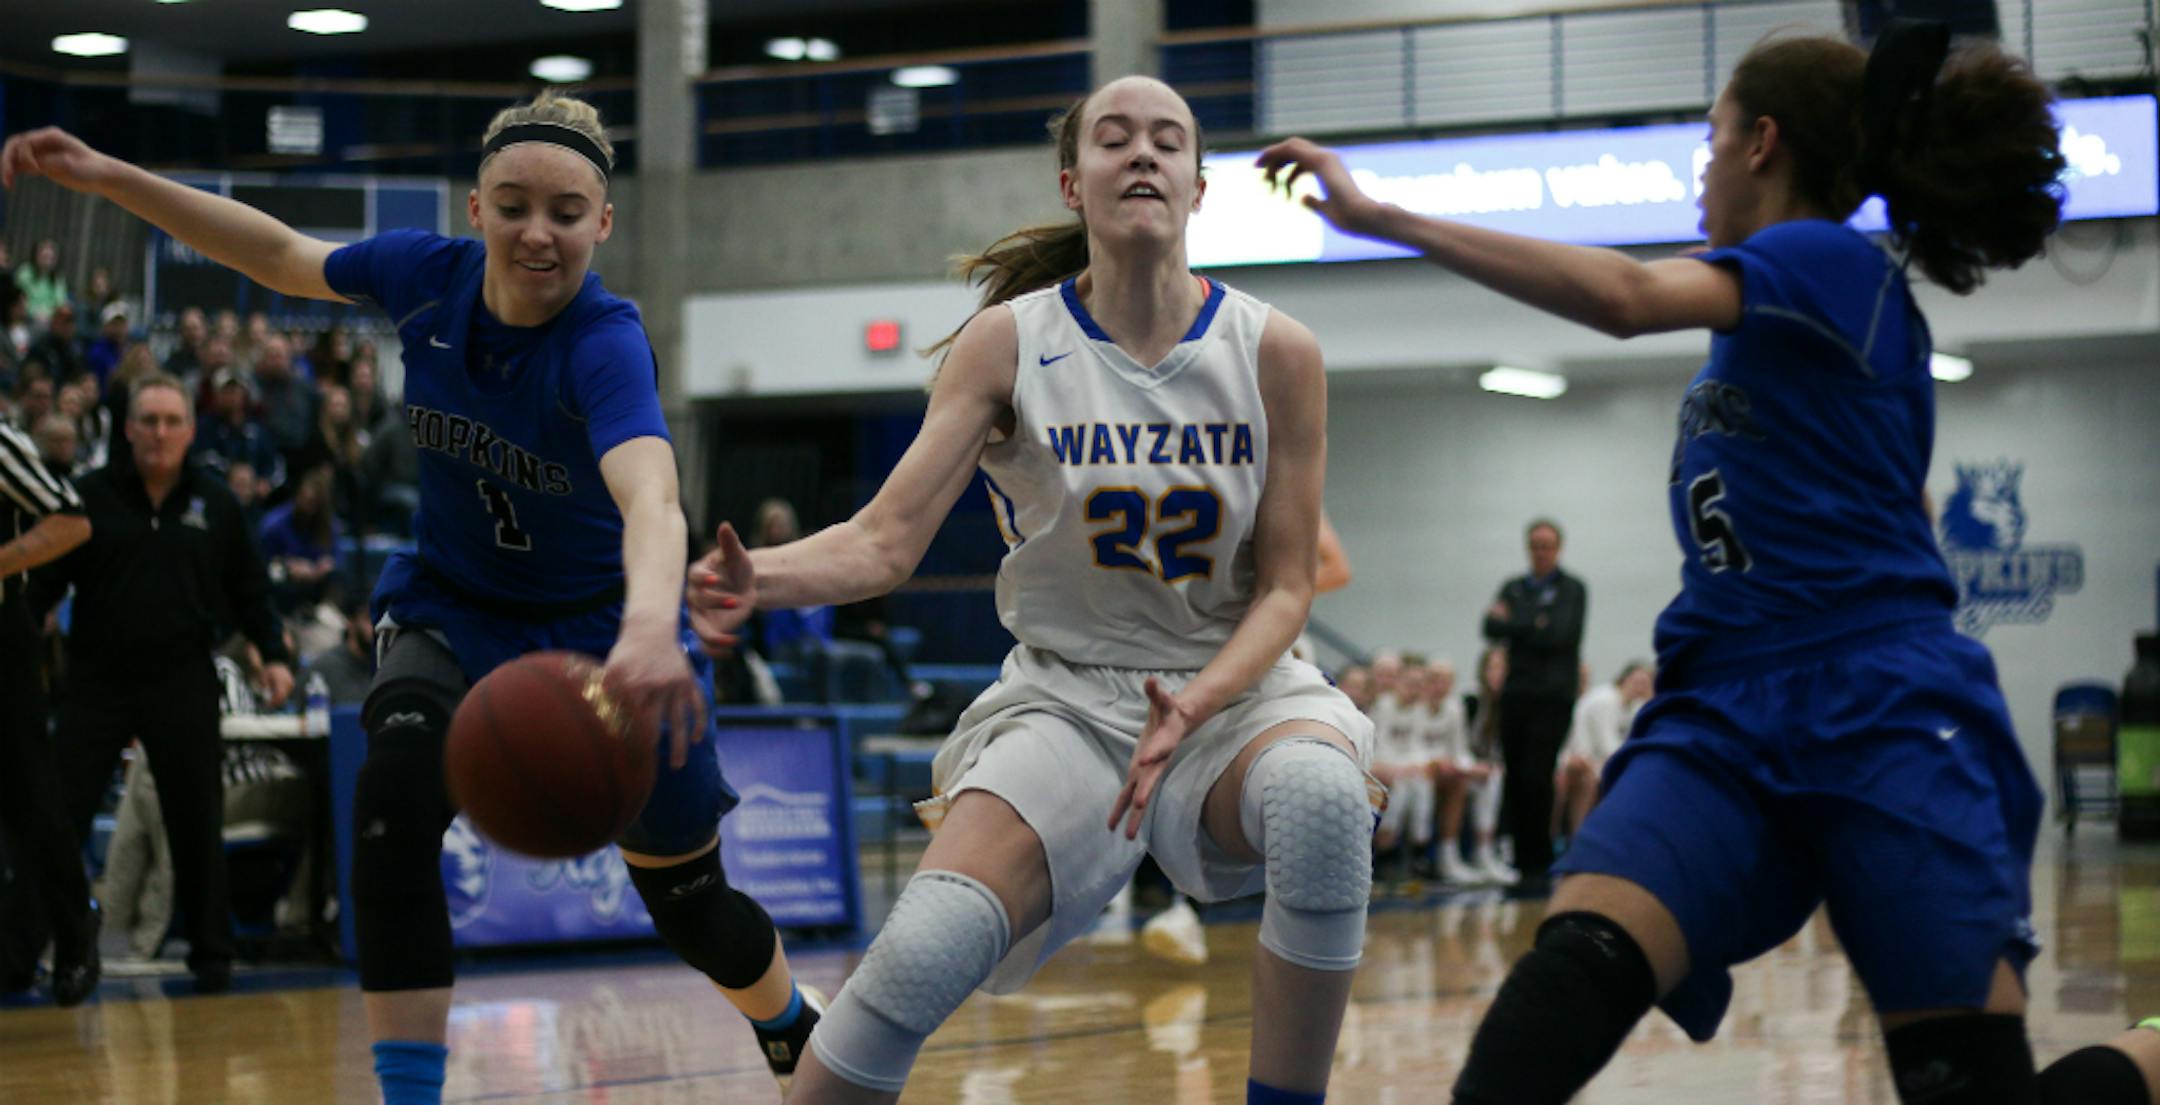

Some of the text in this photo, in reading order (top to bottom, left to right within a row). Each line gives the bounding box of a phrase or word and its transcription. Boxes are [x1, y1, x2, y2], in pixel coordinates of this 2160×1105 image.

[406, 404, 572, 495] HOPKINS
[1046, 422, 1254, 466] WAYZATA
[475, 478, 532, 551] 1
[1083, 485, 1223, 585] 22
[1947, 547, 2083, 592] PKINS
